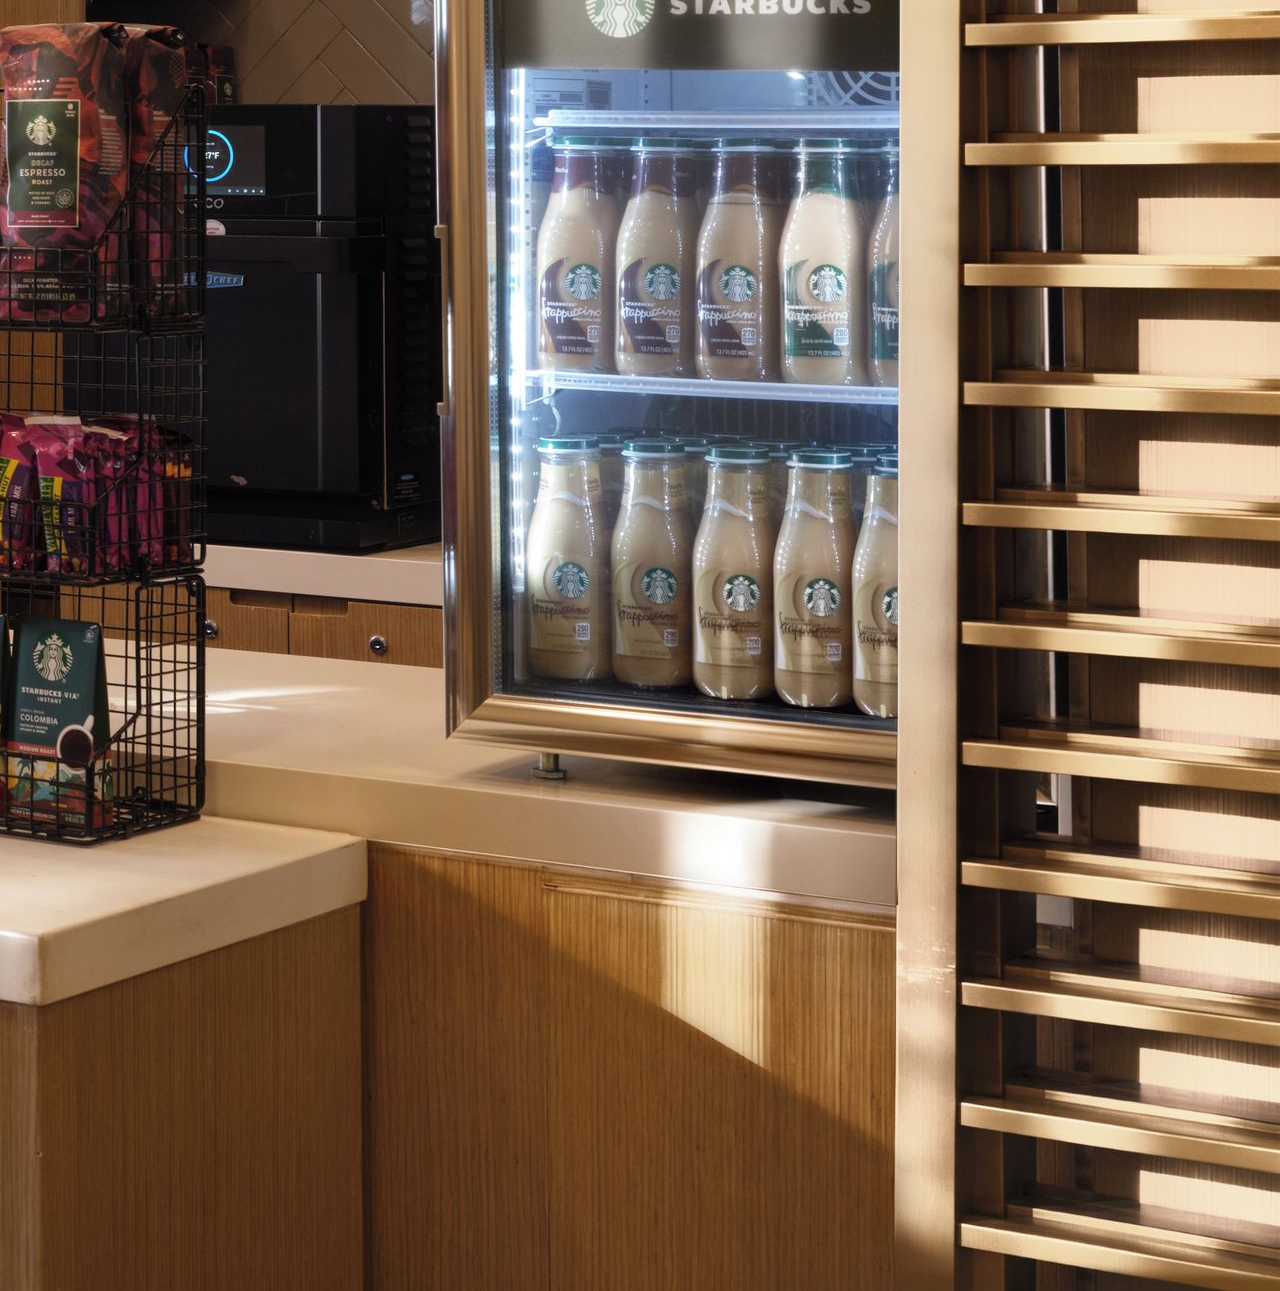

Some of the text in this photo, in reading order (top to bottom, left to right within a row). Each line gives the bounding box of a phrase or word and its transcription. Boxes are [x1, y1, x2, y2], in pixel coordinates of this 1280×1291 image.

[19, 168, 66, 177] ESPRESSO
[541, 296, 601, 324] Frappuccino
[620, 297, 680, 324] Frappuccino
[697, 299, 757, 327] Frappuccino
[0, 476, 10, 492] NUT
[13, 485, 22, 498] MIX
[21, 686, 77, 700] STARBUCKS VIA
[37, 696, 62, 704] INSTANT
[20, 713, 58, 725] COLOMBIA
